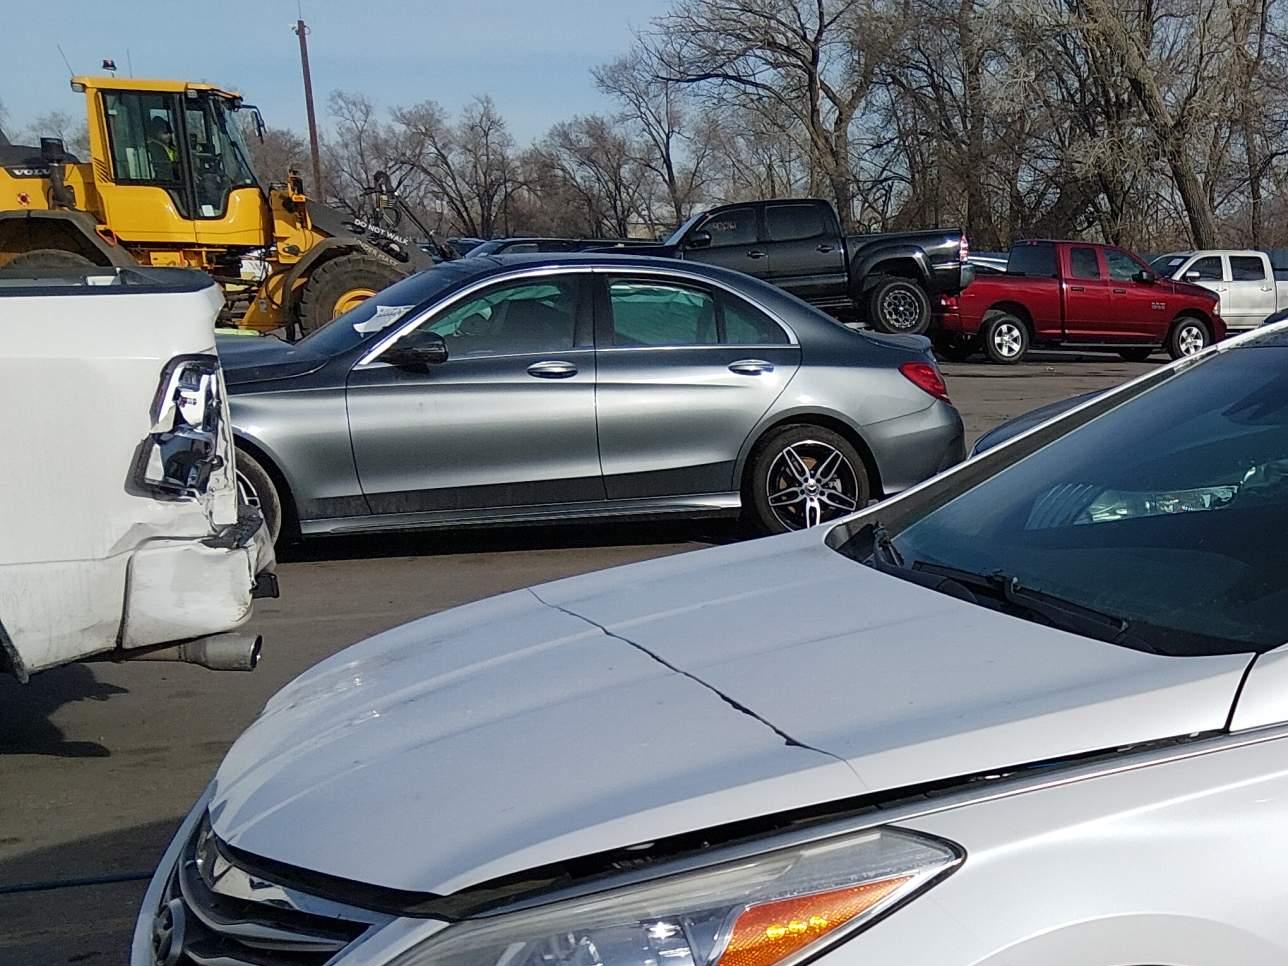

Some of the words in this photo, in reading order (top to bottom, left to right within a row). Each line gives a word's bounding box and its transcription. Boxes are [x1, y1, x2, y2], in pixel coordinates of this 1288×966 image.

[12, 168, 50, 176] VOLV
[354, 219, 367, 228] DO
[368, 224, 385, 235] NOT
[386, 231, 408, 246] WALK
